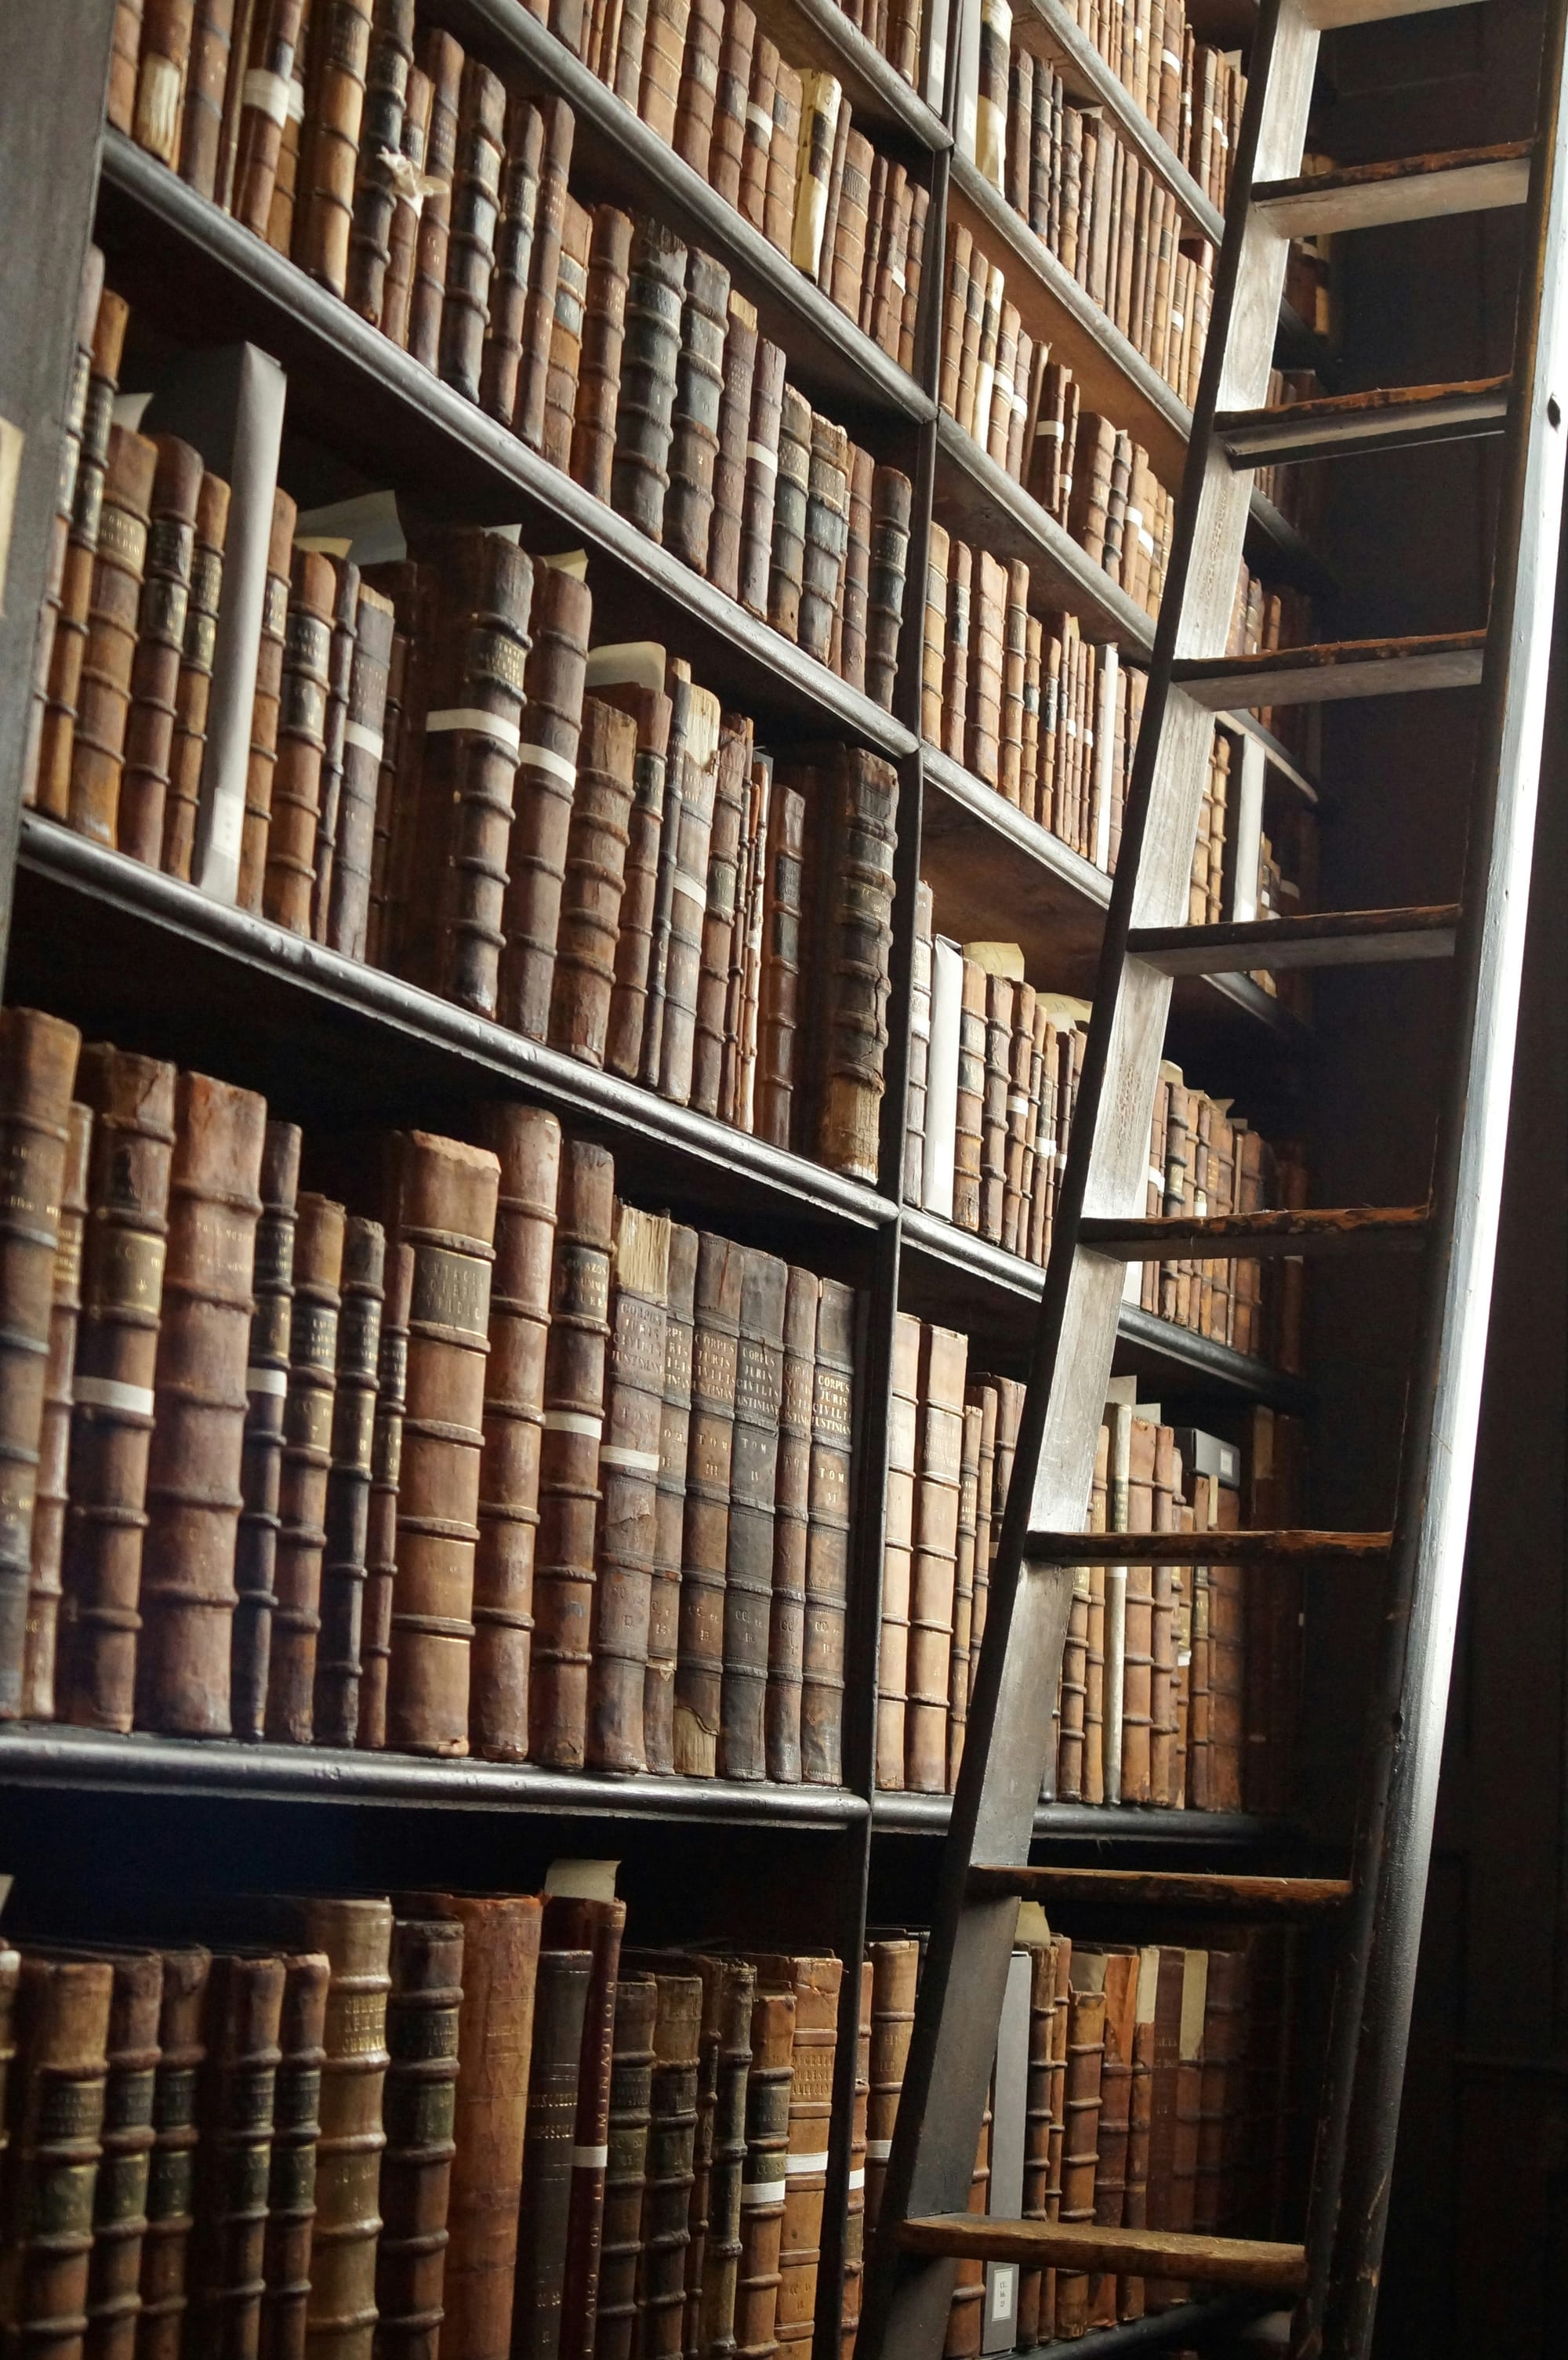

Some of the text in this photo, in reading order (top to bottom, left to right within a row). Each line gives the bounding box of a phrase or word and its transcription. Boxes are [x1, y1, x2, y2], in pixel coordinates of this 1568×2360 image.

[620, 1302, 662, 1327] CORPUS
[624, 1319, 659, 1339] JURIS
[613, 1332, 662, 1357] CIVILIS
[695, 1333, 735, 1355] CORPUS
[698, 1349, 731, 1369] JURIS
[742, 1346, 775, 1367] CORPUS
[745, 1364, 773, 1383] JURIS
[736, 1379, 779, 1400] CIVILIS
[818, 1374, 851, 1394] CORPUS
[820, 1390, 848, 1407] JURIS
[697, 1433, 728, 1452] TOM
[742, 1437, 767, 1454] TOM
[589, 2223, 601, 2248] OF
[584, 2269, 597, 2320] ART
